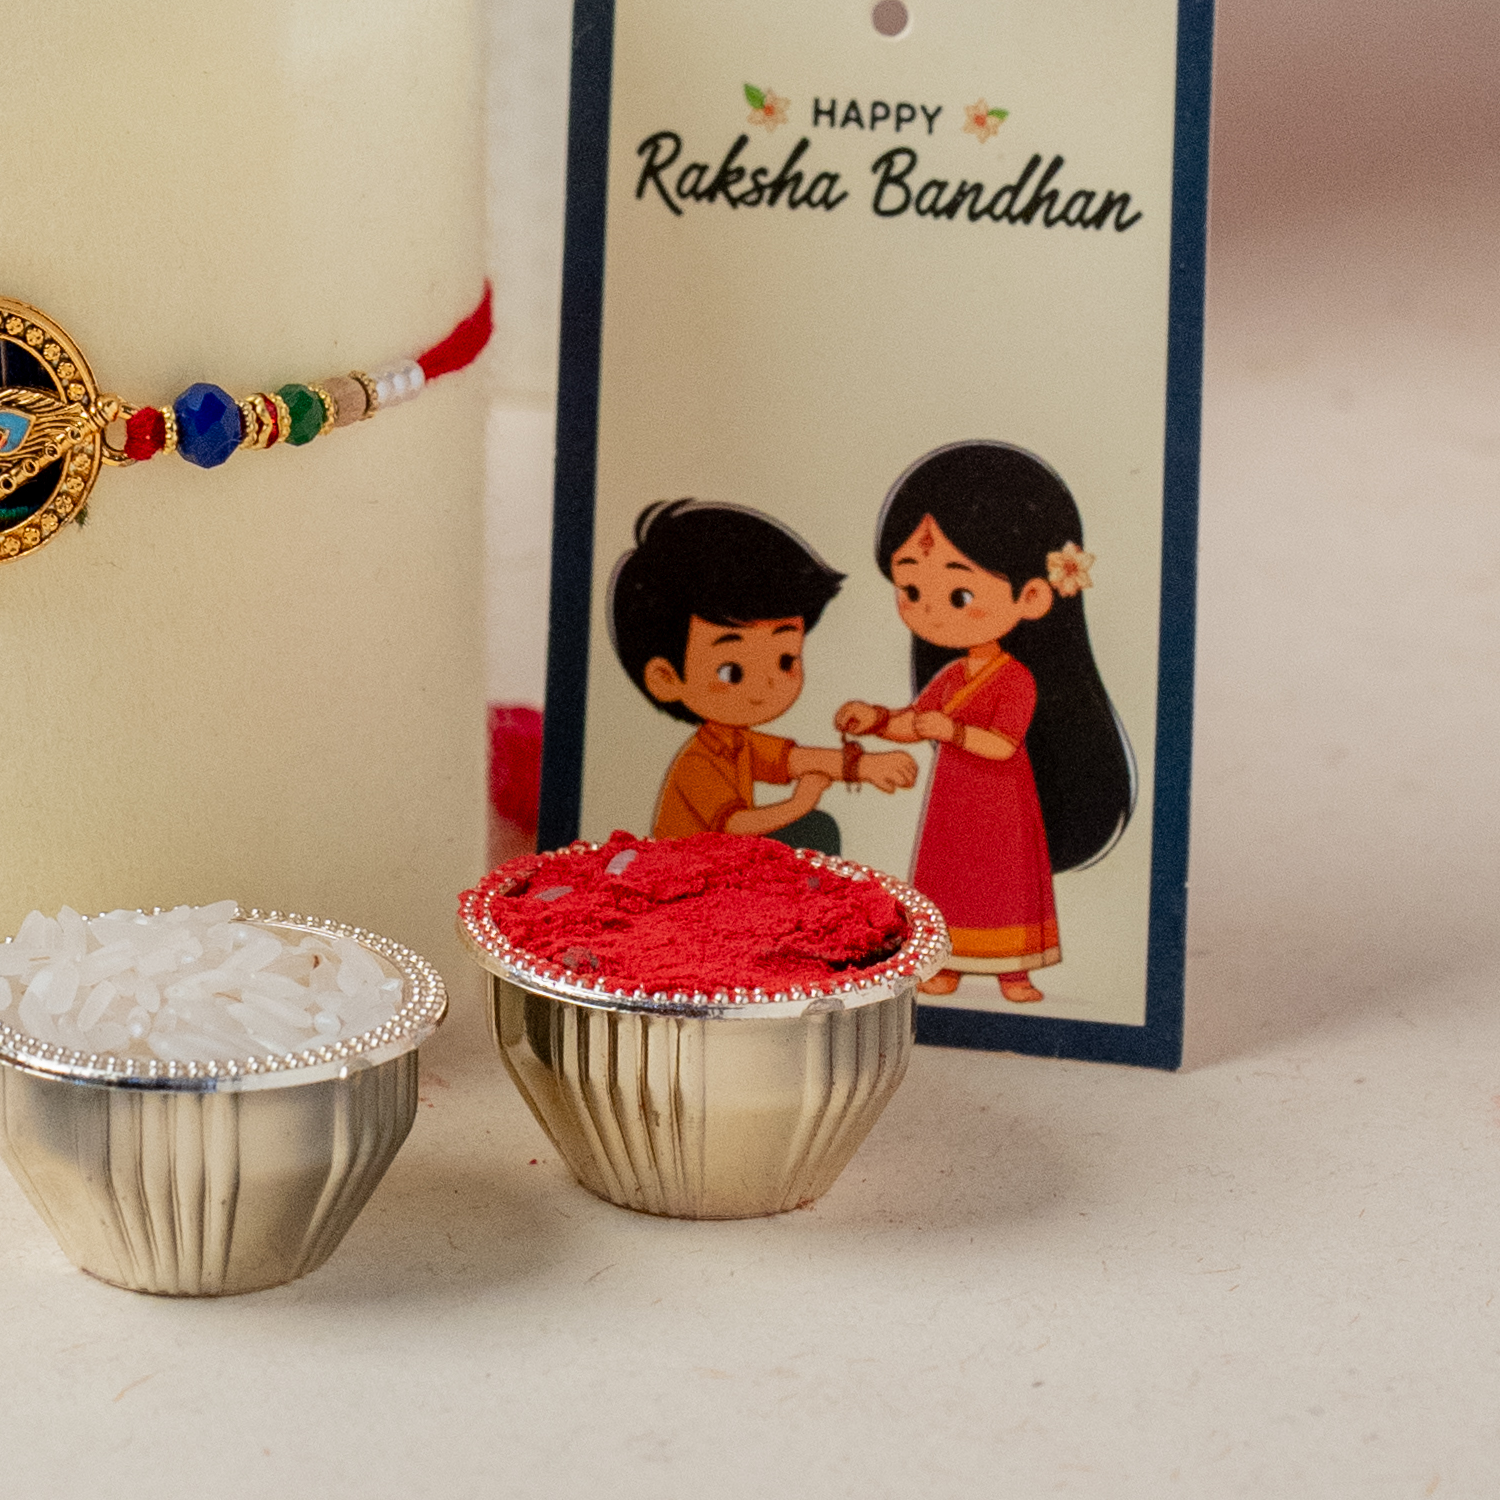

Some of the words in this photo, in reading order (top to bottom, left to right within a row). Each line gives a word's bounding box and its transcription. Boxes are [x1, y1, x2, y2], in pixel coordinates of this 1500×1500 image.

[812, 97, 943, 134] HAPPY
[635, 130, 848, 216] Raksha
[870, 145, 1142, 232] Bandhan
